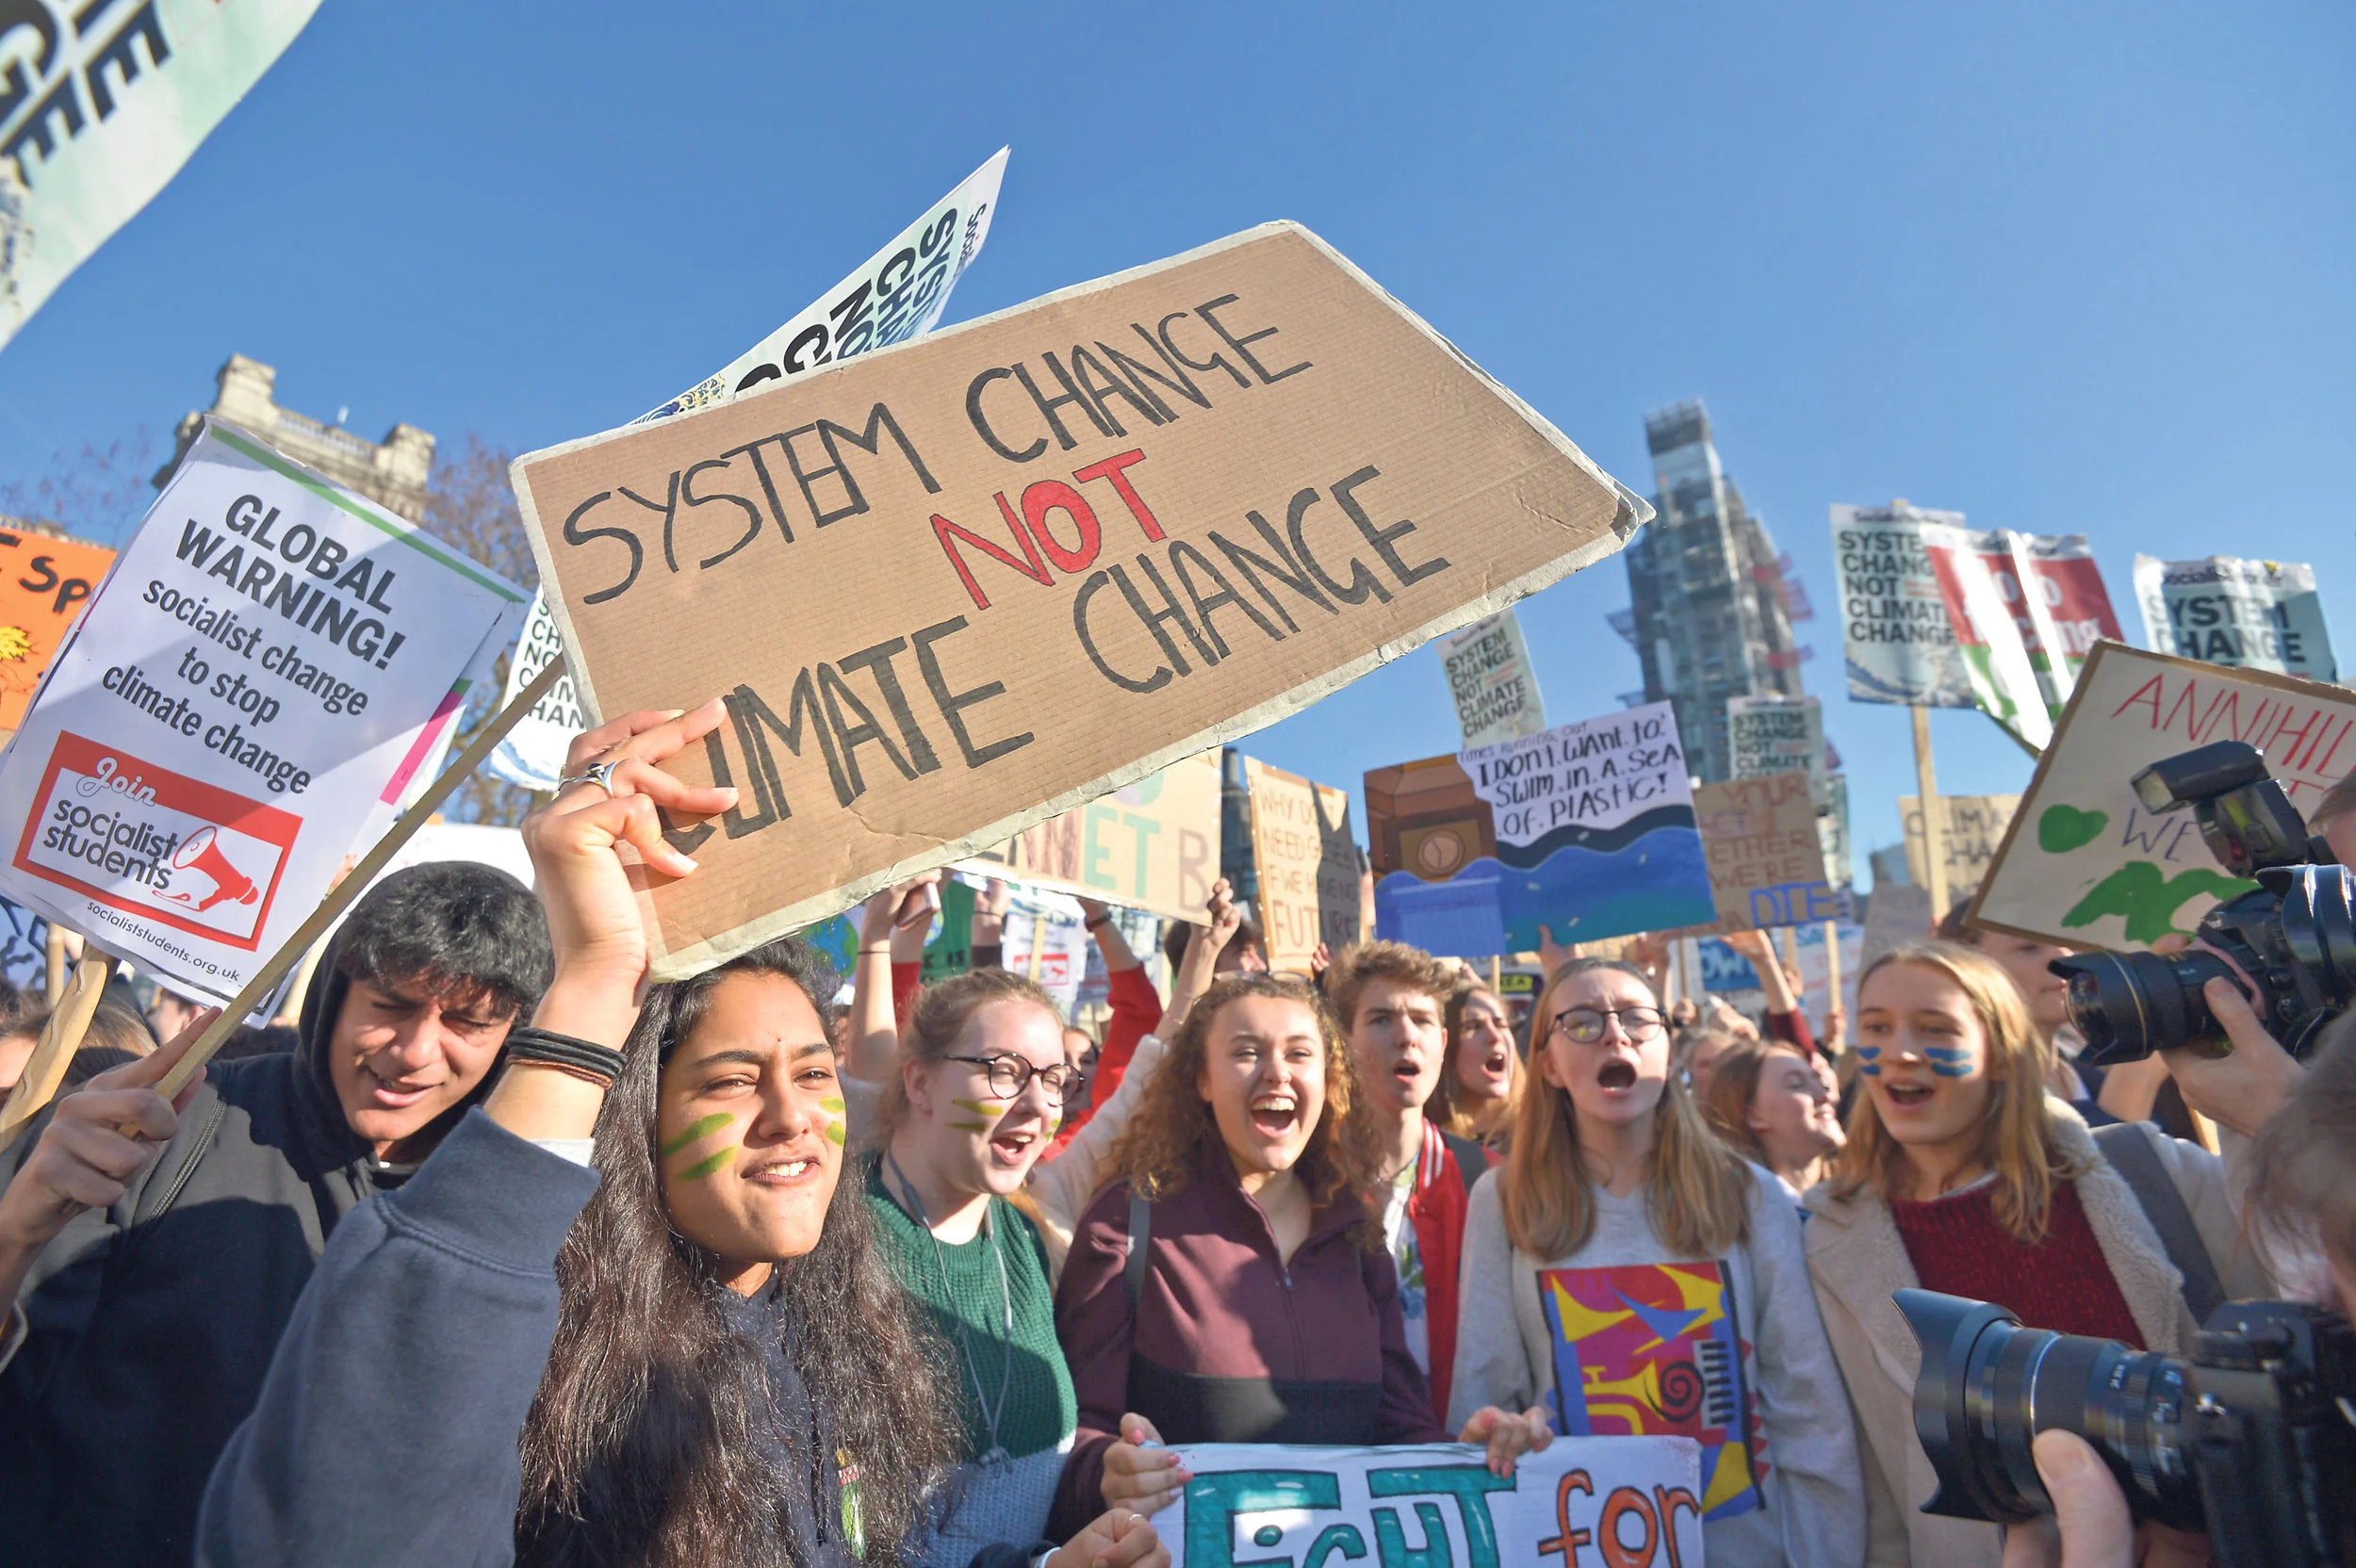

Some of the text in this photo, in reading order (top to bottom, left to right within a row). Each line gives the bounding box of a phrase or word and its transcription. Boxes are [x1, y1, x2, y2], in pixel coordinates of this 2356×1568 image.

[828, 278, 876, 361] NO
[563, 292, 1315, 606] SYSTEM CHANGE
[225, 494, 397, 616] GLOBAL
[929, 447, 1169, 612] NOT
[1839, 531, 1925, 554] SYSTE
[1842, 553, 1934, 578] CHANG
[175, 517, 407, 671] WARNING!
[1072, 464, 1453, 694] CHANGE
[1844, 576, 1900, 597] NOT
[142, 579, 369, 716] socialist change
[176, 645, 282, 727] to stop
[1446, 627, 1508, 674] SYSTEM
[1451, 642, 1515, 689] CHANGE
[101, 663, 312, 795] climate change
[1455, 678, 1483, 707] NOT
[1460, 675, 1526, 722] CLIMATE
[2110, 672, 2356, 780] ANNIHIL
[75, 756, 157, 808] Join
[42, 823, 174, 890] students
[53, 798, 179, 861] socialist
[975, 803, 1162, 900] NET
[87, 900, 241, 982] socialiststudents.org.uk
[1749, 880, 1835, 929] DIE
